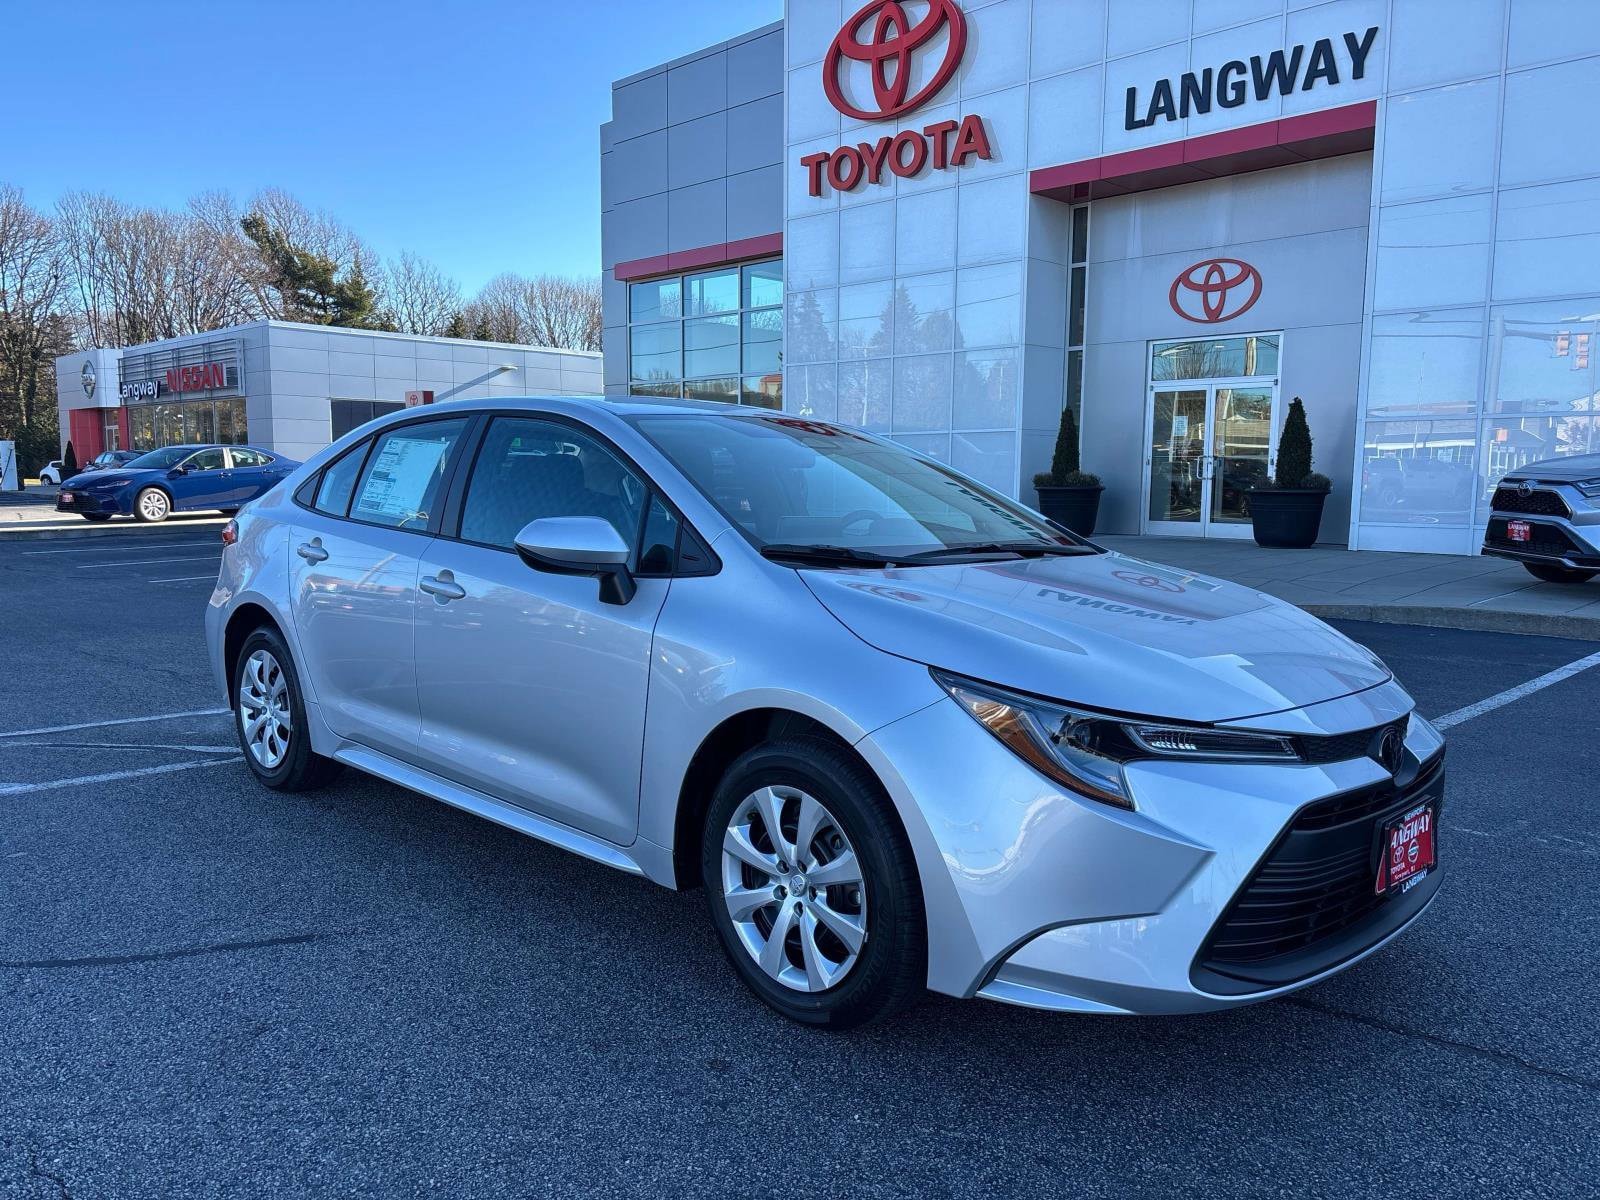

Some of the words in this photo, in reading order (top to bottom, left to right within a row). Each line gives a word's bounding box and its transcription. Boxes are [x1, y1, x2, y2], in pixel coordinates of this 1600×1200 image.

[1124, 26, 1380, 131] LANGWAY
[800, 113, 991, 198] TOYOTA
[166, 362, 226, 393] NISSAN
[1390, 814, 1431, 849] ANGWAY
[1401, 867, 1428, 894] LANGWAY
